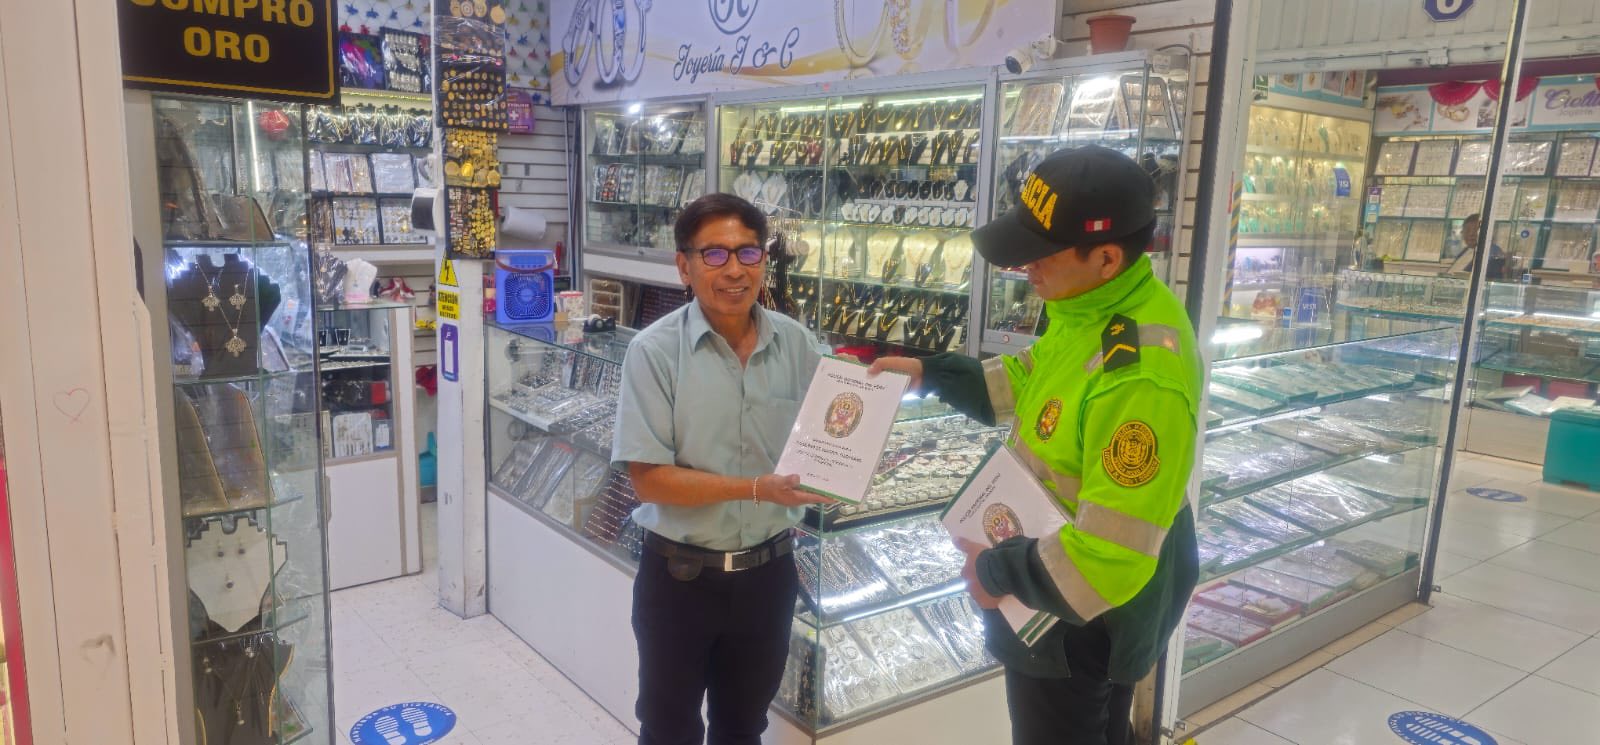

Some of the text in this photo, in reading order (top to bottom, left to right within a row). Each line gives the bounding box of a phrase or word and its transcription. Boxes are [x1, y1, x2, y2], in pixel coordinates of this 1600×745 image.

[130, 0, 315, 28] MPRO
[183, 26, 270, 63] ORO
[673, 27, 800, 84] Joyería J & C
